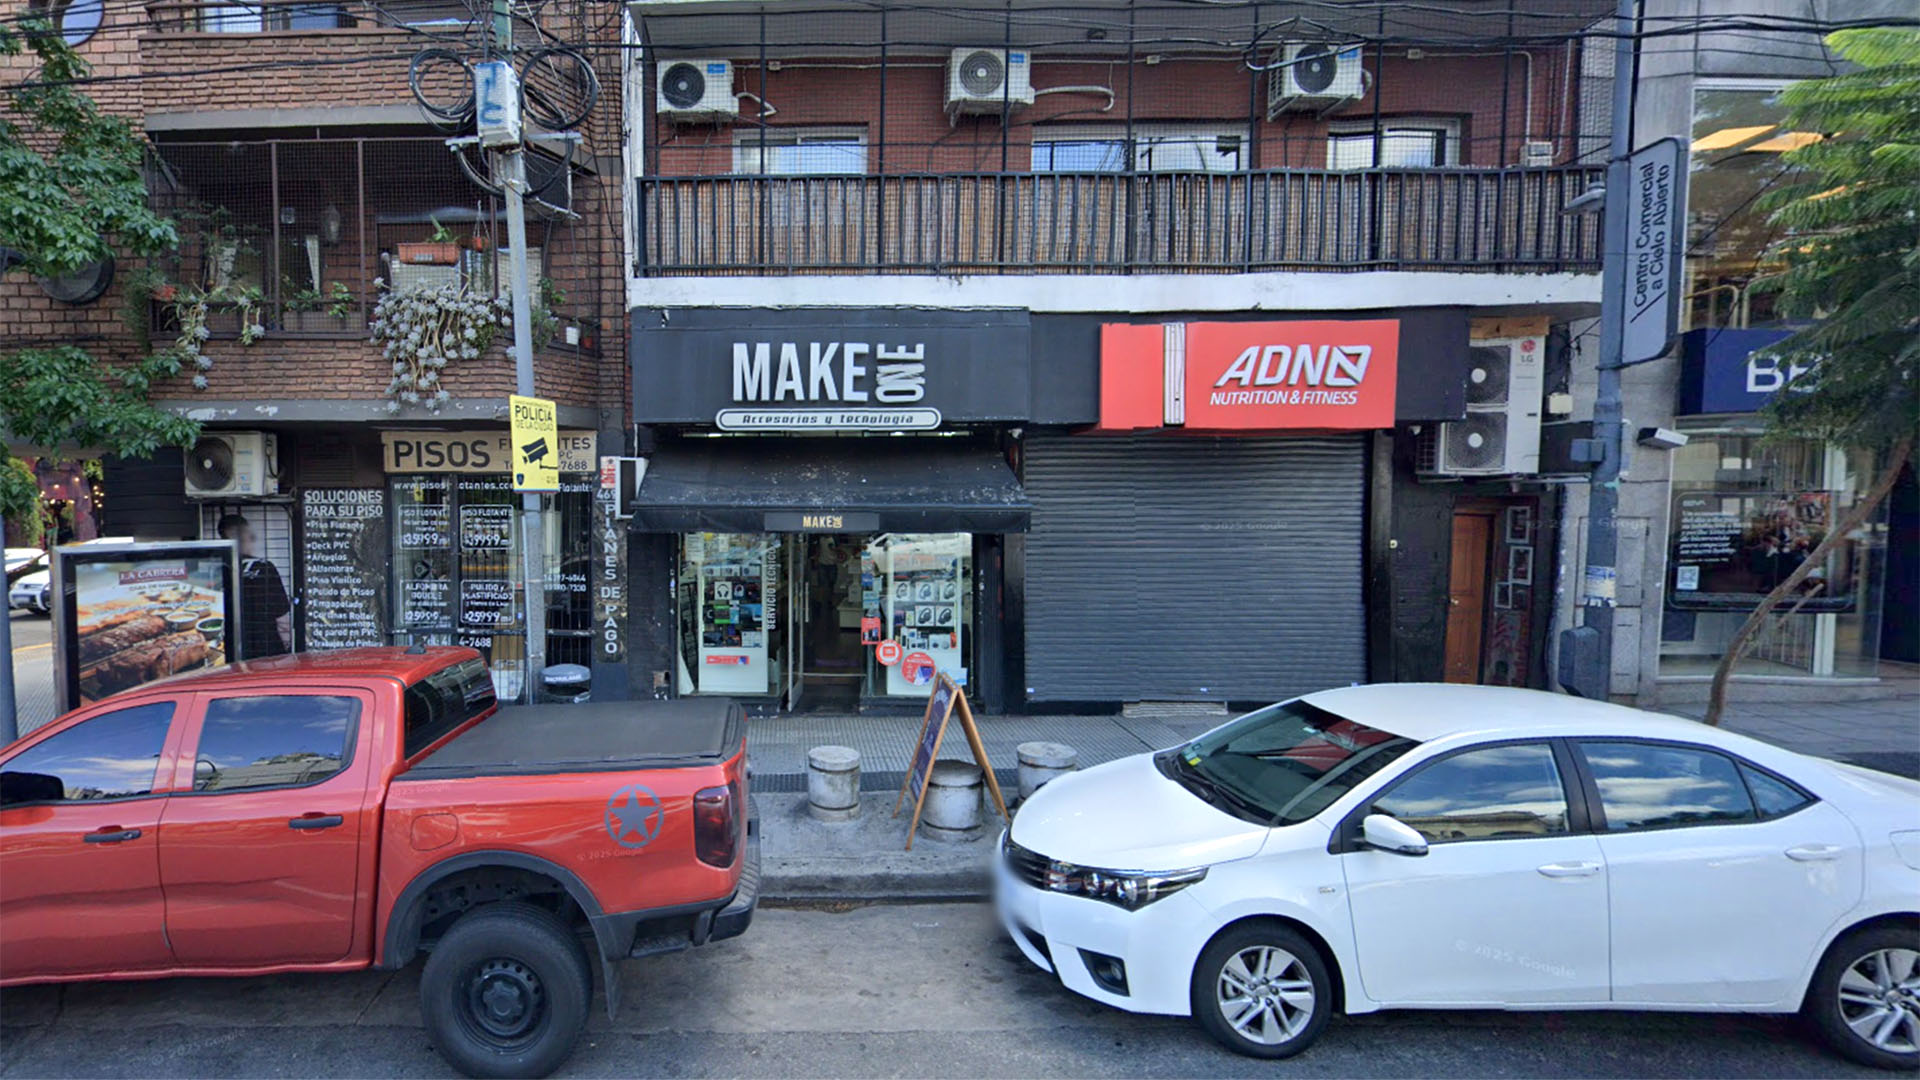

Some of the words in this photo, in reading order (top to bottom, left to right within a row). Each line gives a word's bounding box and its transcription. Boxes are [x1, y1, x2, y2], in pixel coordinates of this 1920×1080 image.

[1654, 164, 1670, 225] Abierto
[1636, 161, 1654, 247] Comercial
[1651, 231, 1665, 274] Cielo
[1634, 253, 1649, 307] Centro
[1651, 279, 1662, 290] a
[733, 342, 869, 401] MAKE
[875, 343, 925, 403] ONE
[1210, 391, 1288, 405] NUTRITION
[1289, 390, 1300, 404] &
[1302, 391, 1357, 404] FITNESS
[743, 414, 817, 424] Accesorios
[825, 415, 833, 425] y
[393, 440, 490, 468] PISOS
[304, 490, 383, 502] SOLUCIONES
[305, 505, 336, 516] PARA
[338, 505, 354, 516] SU
[356, 505, 383, 517] PISO
[803, 515, 832, 528] MAKE
[311, 541, 332, 549] Deck
[333, 541, 350, 549] PVC
[311, 565, 354, 573] Alfombras
[601, 587, 620, 598] DE
[767, 587, 776, 630] SERVICIO
[604, 605, 617, 653] PAGO
